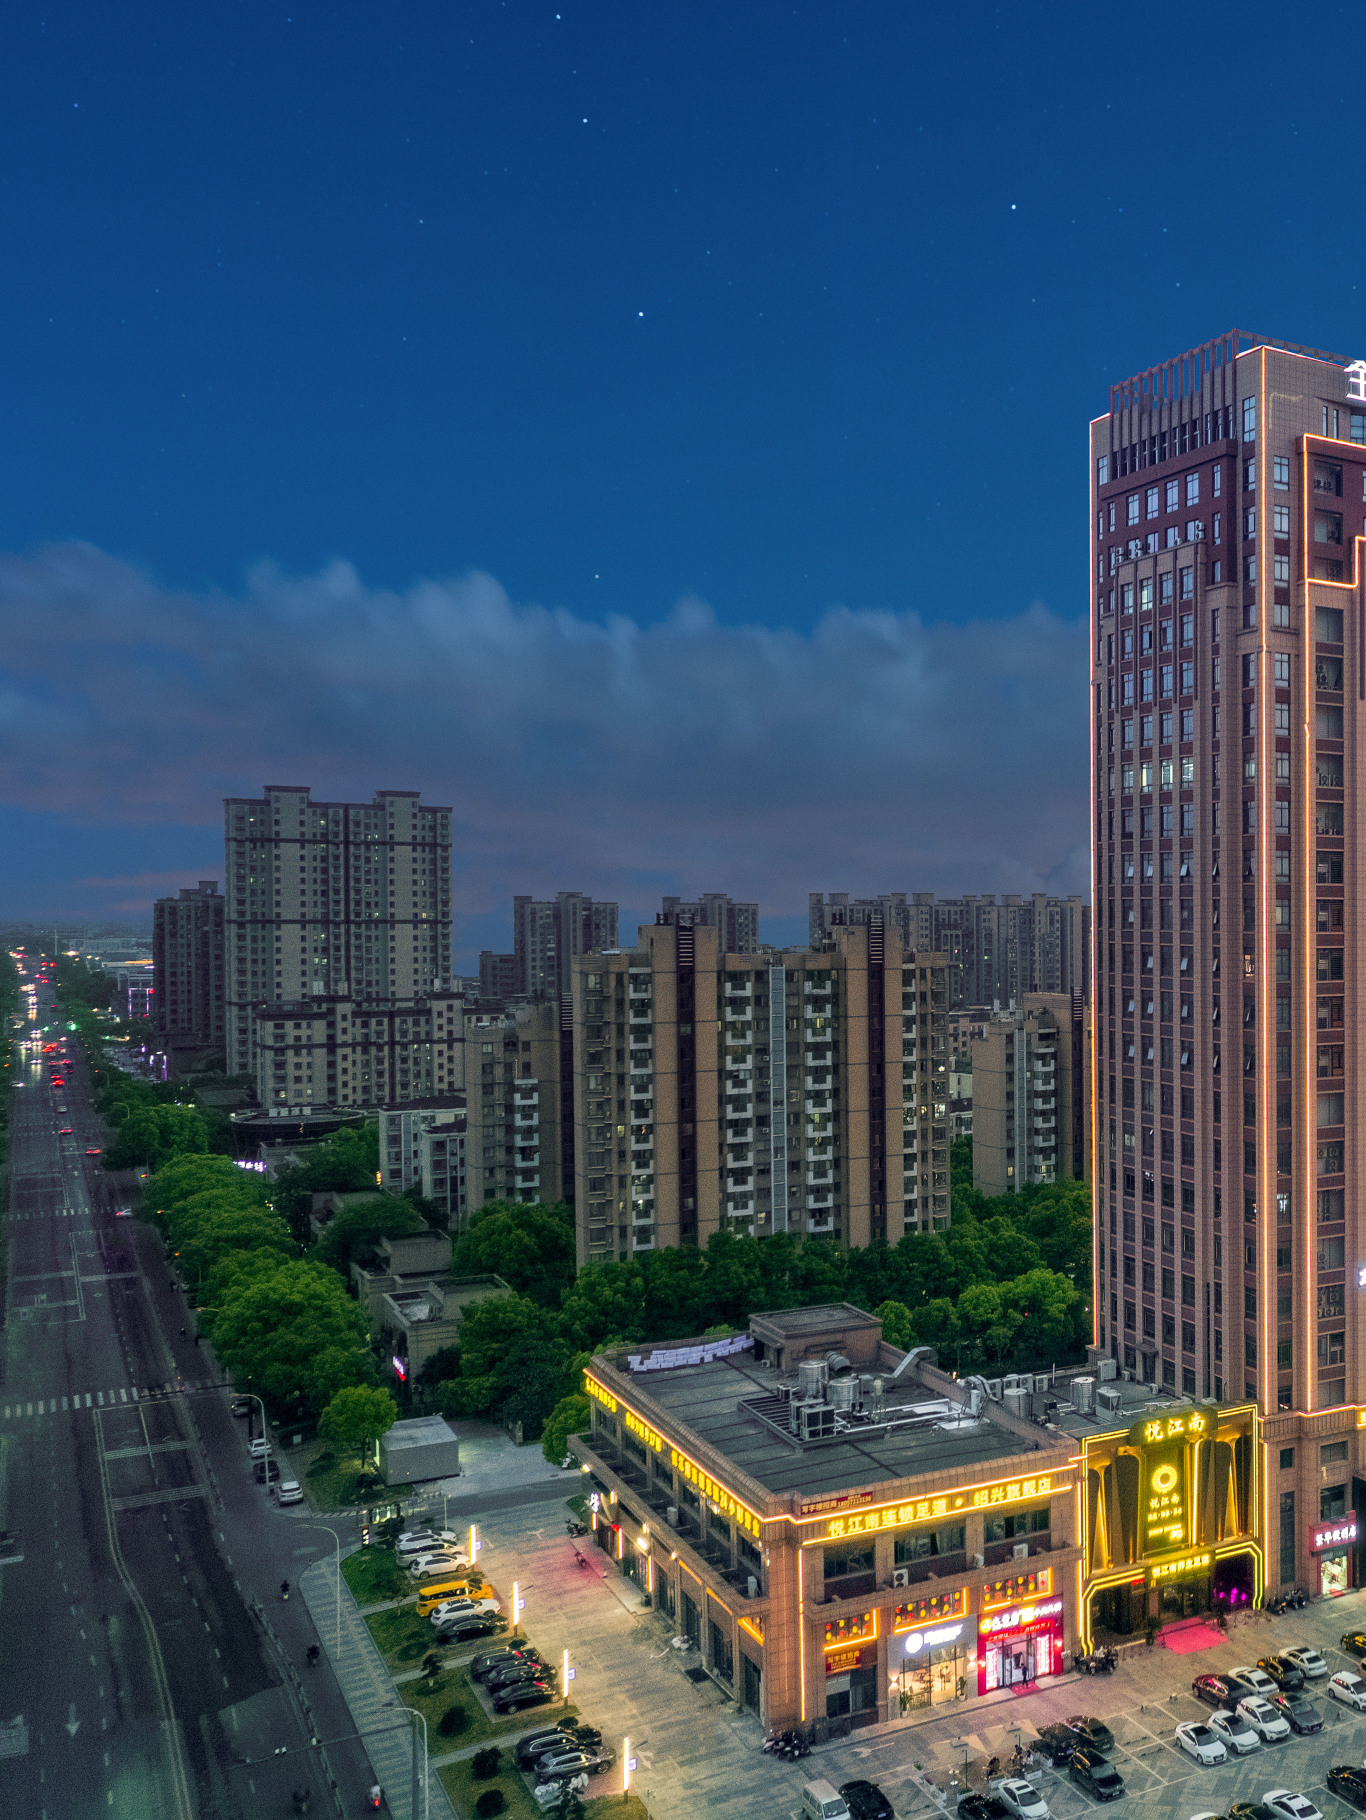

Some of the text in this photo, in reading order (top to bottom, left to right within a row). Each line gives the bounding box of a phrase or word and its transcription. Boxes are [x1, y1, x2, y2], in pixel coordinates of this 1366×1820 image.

[1145, 1412, 1206, 1443] 悦江南
[828, 1476, 1052, 1537] 悦江南连锁足道 绍兴旗舰店
